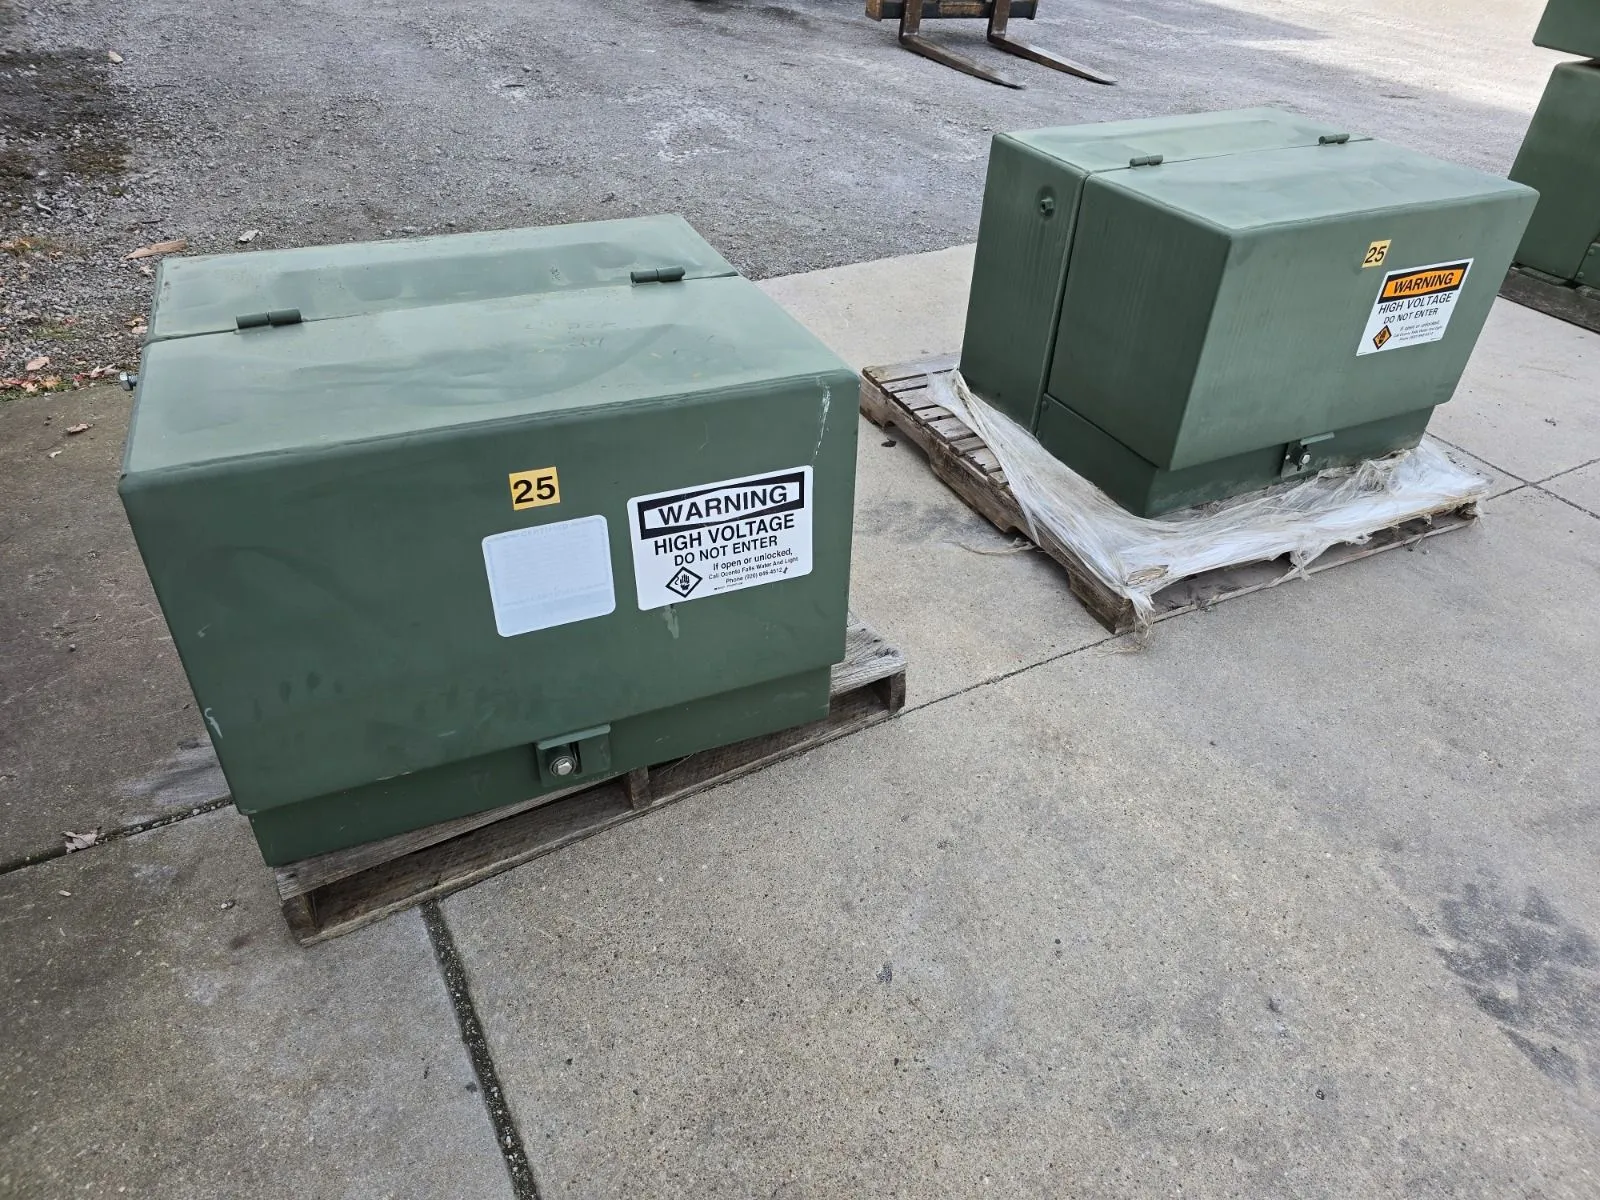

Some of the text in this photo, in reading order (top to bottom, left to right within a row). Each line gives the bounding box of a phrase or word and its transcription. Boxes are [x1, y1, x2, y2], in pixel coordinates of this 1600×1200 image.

[1364, 245, 1387, 264] 25
[1393, 272, 1455, 294] WARNING
[1378, 292, 1454, 315] HIGH VOLTAGE
[1383, 307, 1439, 325] DO NOT ENTER
[513, 475, 556, 505] 25
[658, 485, 788, 526] WARNING
[654, 513, 795, 556] HIGH VOLTAGE
[674, 535, 778, 567] DO NOT ENTER
[713, 548, 793, 571] If open or unlocked,
